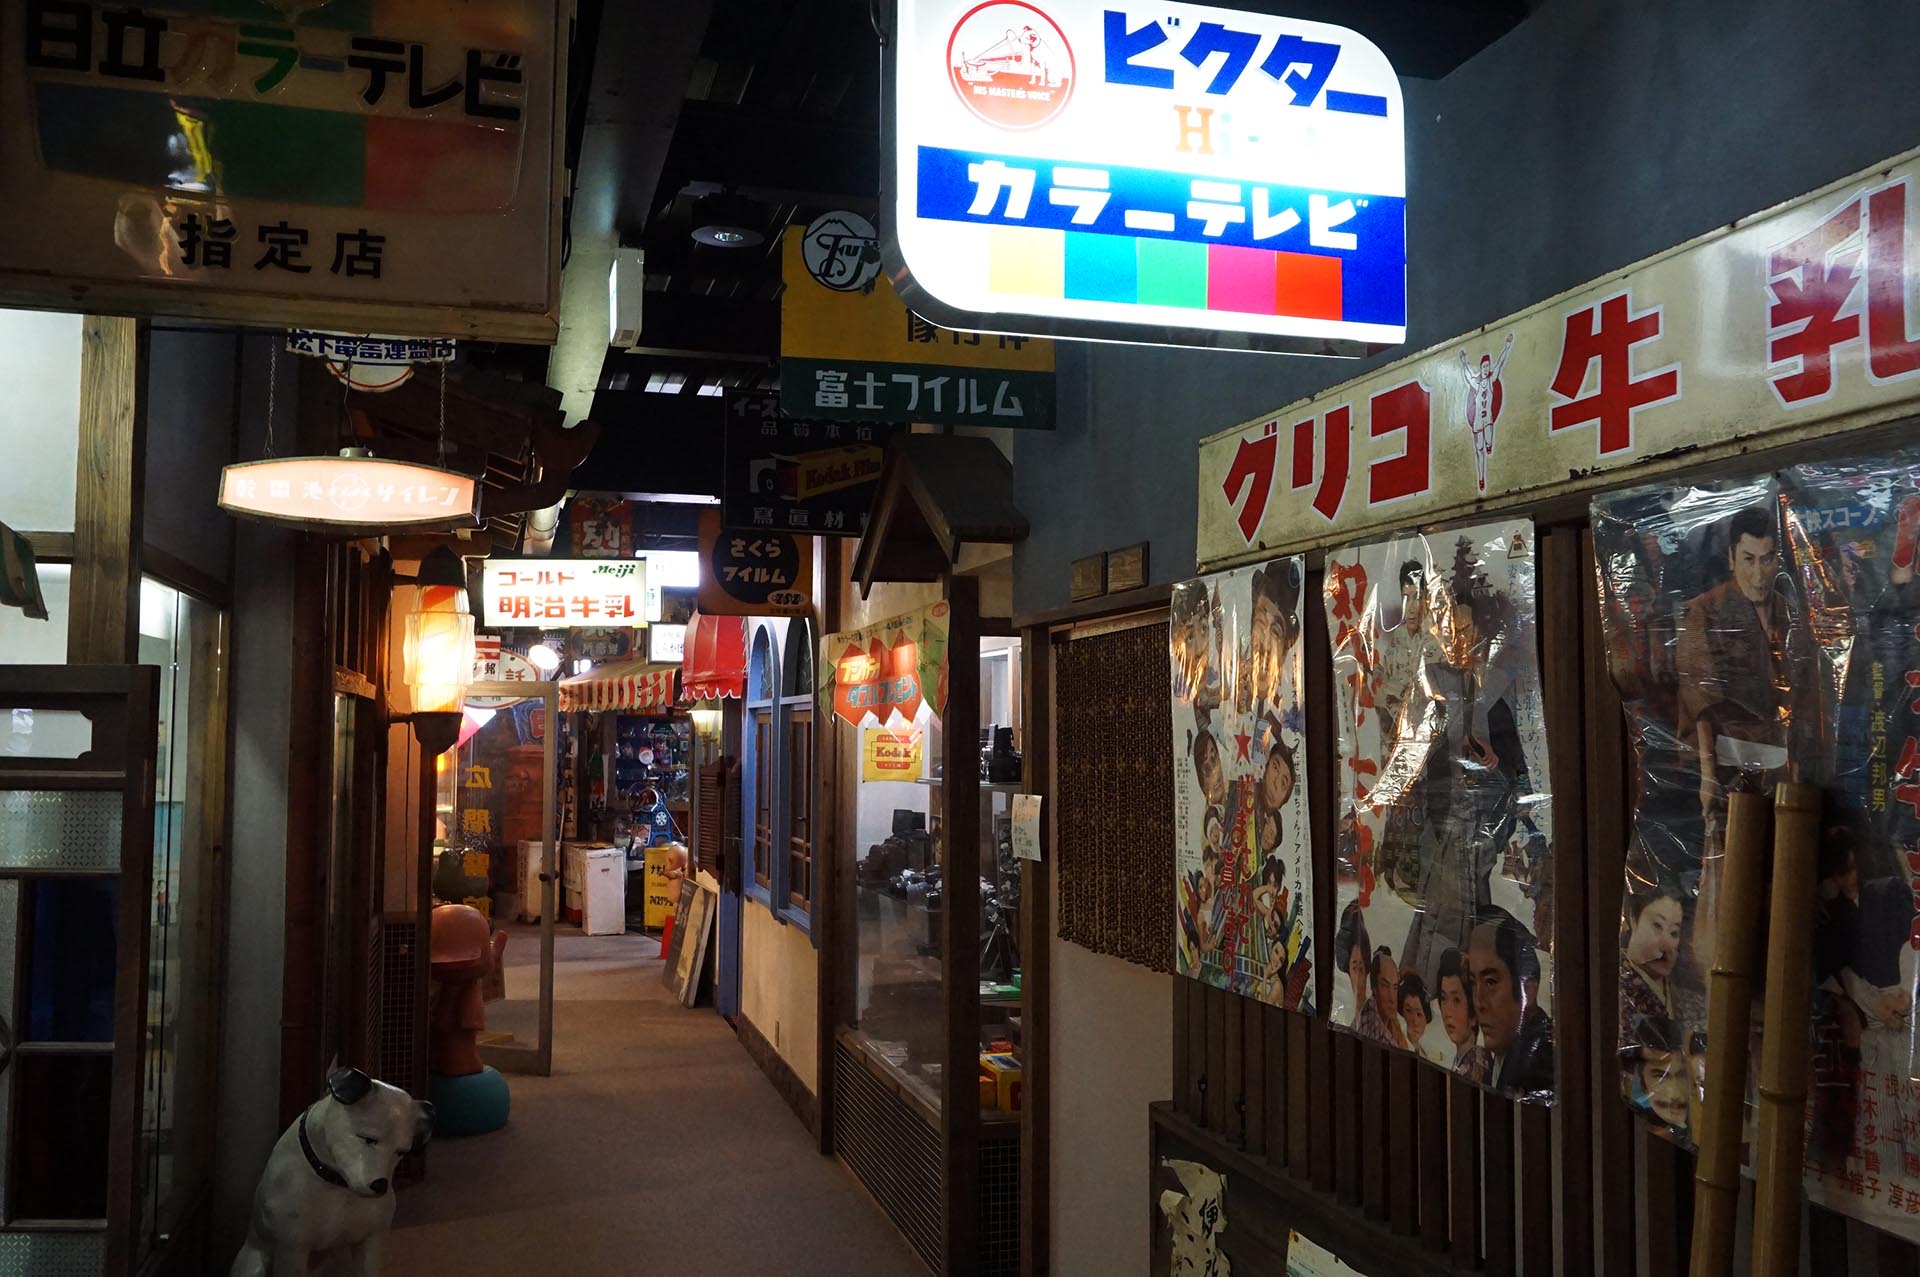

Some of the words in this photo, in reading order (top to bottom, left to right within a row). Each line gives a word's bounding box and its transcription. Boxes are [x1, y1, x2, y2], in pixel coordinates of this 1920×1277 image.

[26, 1, 521, 122] 日立カラーテレビ
[1102, 9, 1388, 117] ビクター
[967, 159, 1370, 250] カラーテレビ
[179, 213, 387, 279] 指定店
[1222, 379, 1430, 545] グリコ
[1550, 178, 1920, 456] 牛乳
[815, 369, 1024, 416] 富士フイルム
[592, 564, 636, 578] Meiji
[731, 538, 781, 558] さくら
[723, 566, 786, 584] フイルム
[498, 594, 635, 618] 明治牛乳
[876, 746, 912, 758] Kodak
